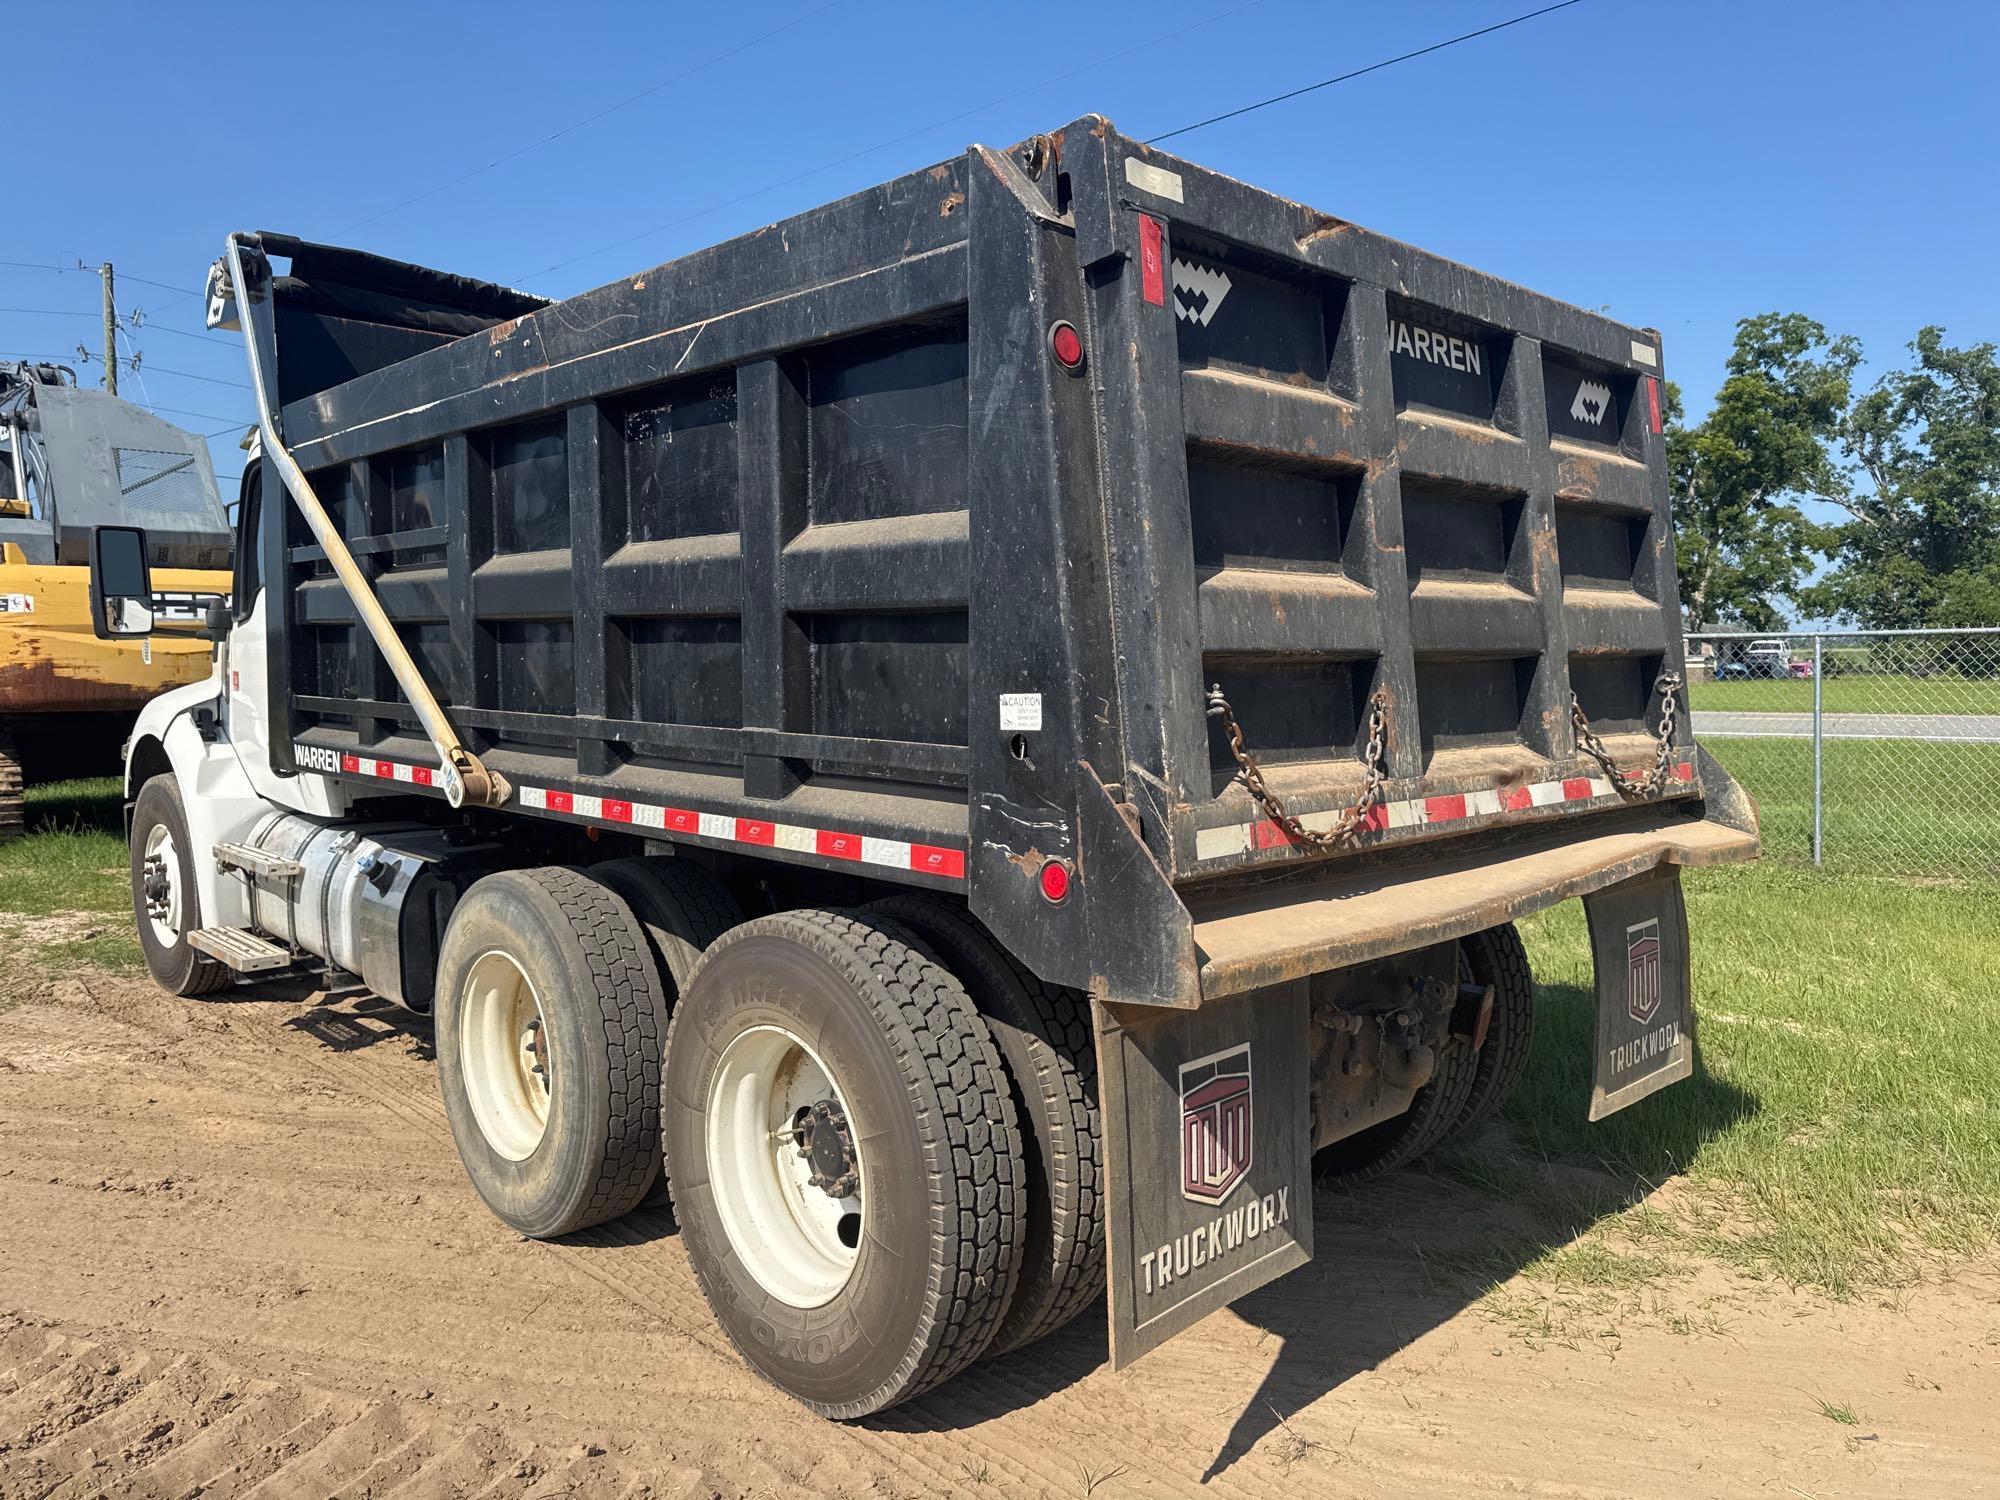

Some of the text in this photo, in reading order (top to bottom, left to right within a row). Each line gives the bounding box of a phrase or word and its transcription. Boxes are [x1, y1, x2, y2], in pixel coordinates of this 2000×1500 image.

[1009, 697, 1041, 707] CAUTION
[294, 744, 341, 773] WARREN
[1610, 1021, 1680, 1076] TRUCKWORX
[1140, 1186, 1290, 1296] TRUCKWORX
[749, 1315, 861, 1365] TOYO
